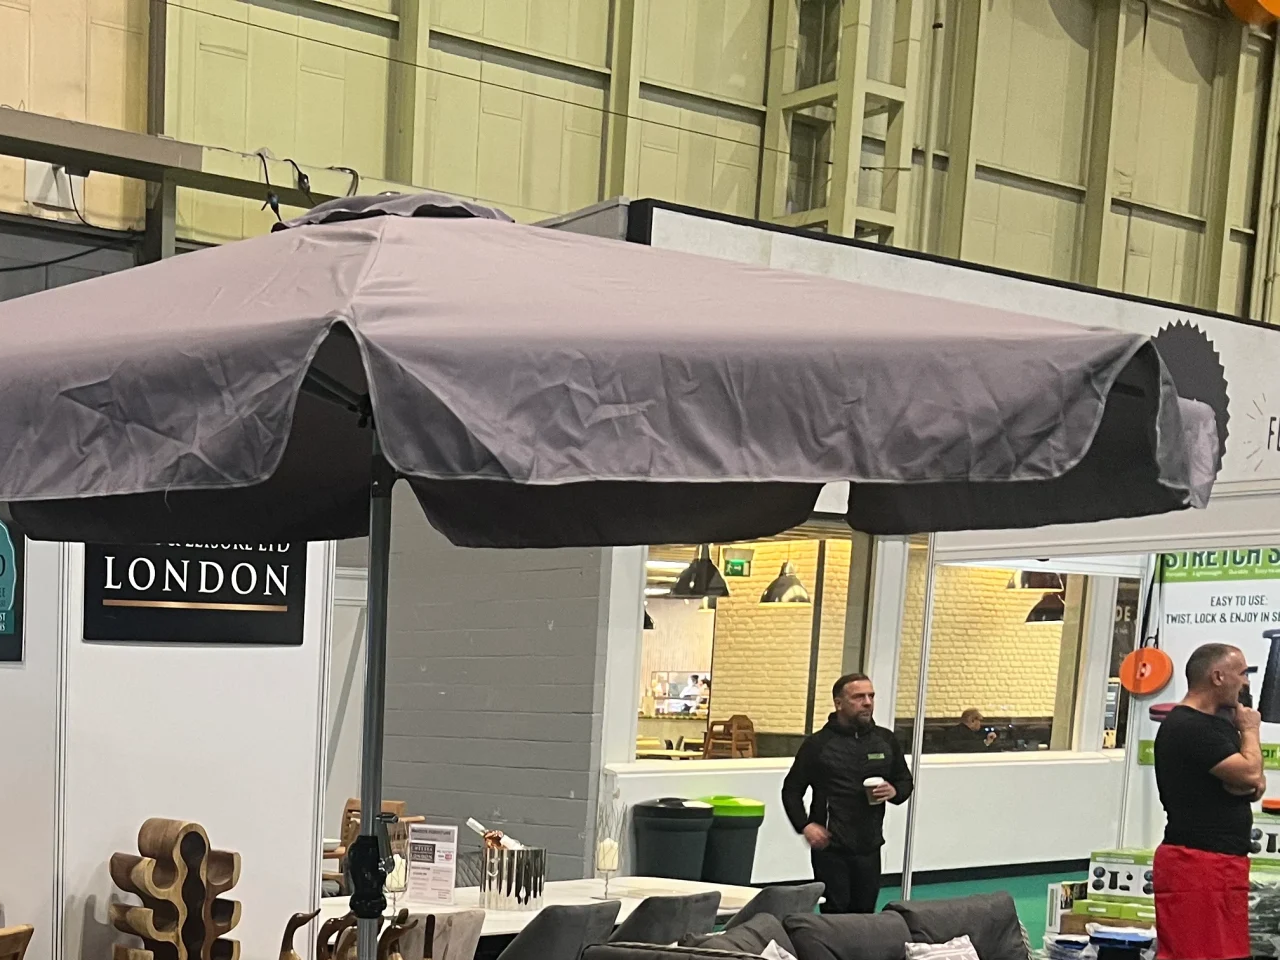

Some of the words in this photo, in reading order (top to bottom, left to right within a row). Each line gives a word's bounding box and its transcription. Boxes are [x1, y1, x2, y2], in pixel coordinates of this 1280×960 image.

[104, 556, 290, 596] LONDON
[1211, 595, 1233, 607] EASY
[1235, 595, 1246, 606] TO
[1166, 614, 1192, 624] TWIST,
[1195, 613, 1216, 624] LOCK
[1220, 613, 1227, 623] &
[1230, 612, 1258, 623] ENJOY
[1261, 612, 1269, 622] IN
